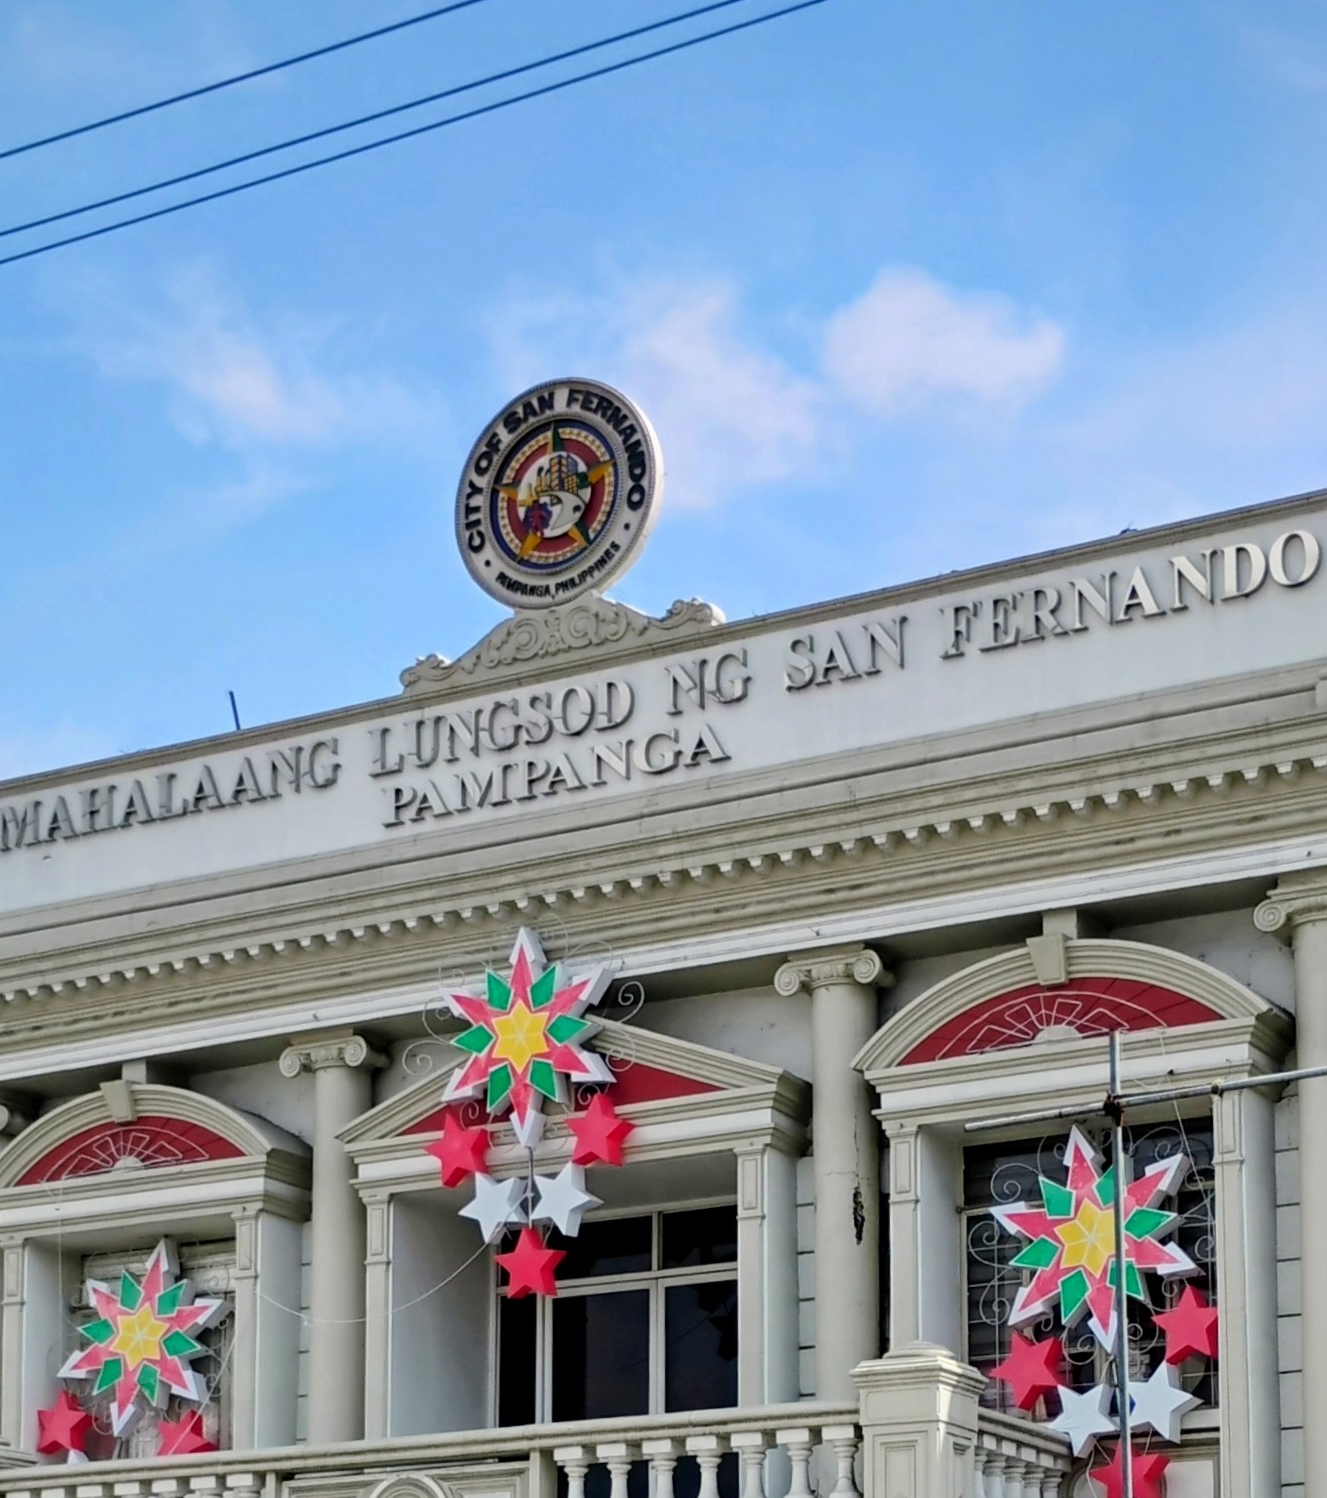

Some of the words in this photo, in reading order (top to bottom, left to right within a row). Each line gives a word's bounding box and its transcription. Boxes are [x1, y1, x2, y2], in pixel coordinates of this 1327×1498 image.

[464, 479, 485, 553] CITY
[475, 431, 502, 477] OF
[503, 391, 555, 434] SAN
[565, 388, 647, 511] FERNANDO
[554, 540, 621, 595] PHILIPPINES
[368, 680, 635, 778] LUNGSOD
[665, 648, 752, 716] NG
[784, 615, 908, 692] SAN
[939, 529, 1322, 659] FERNANDO
[382, 724, 732, 828] PAMPANGA
